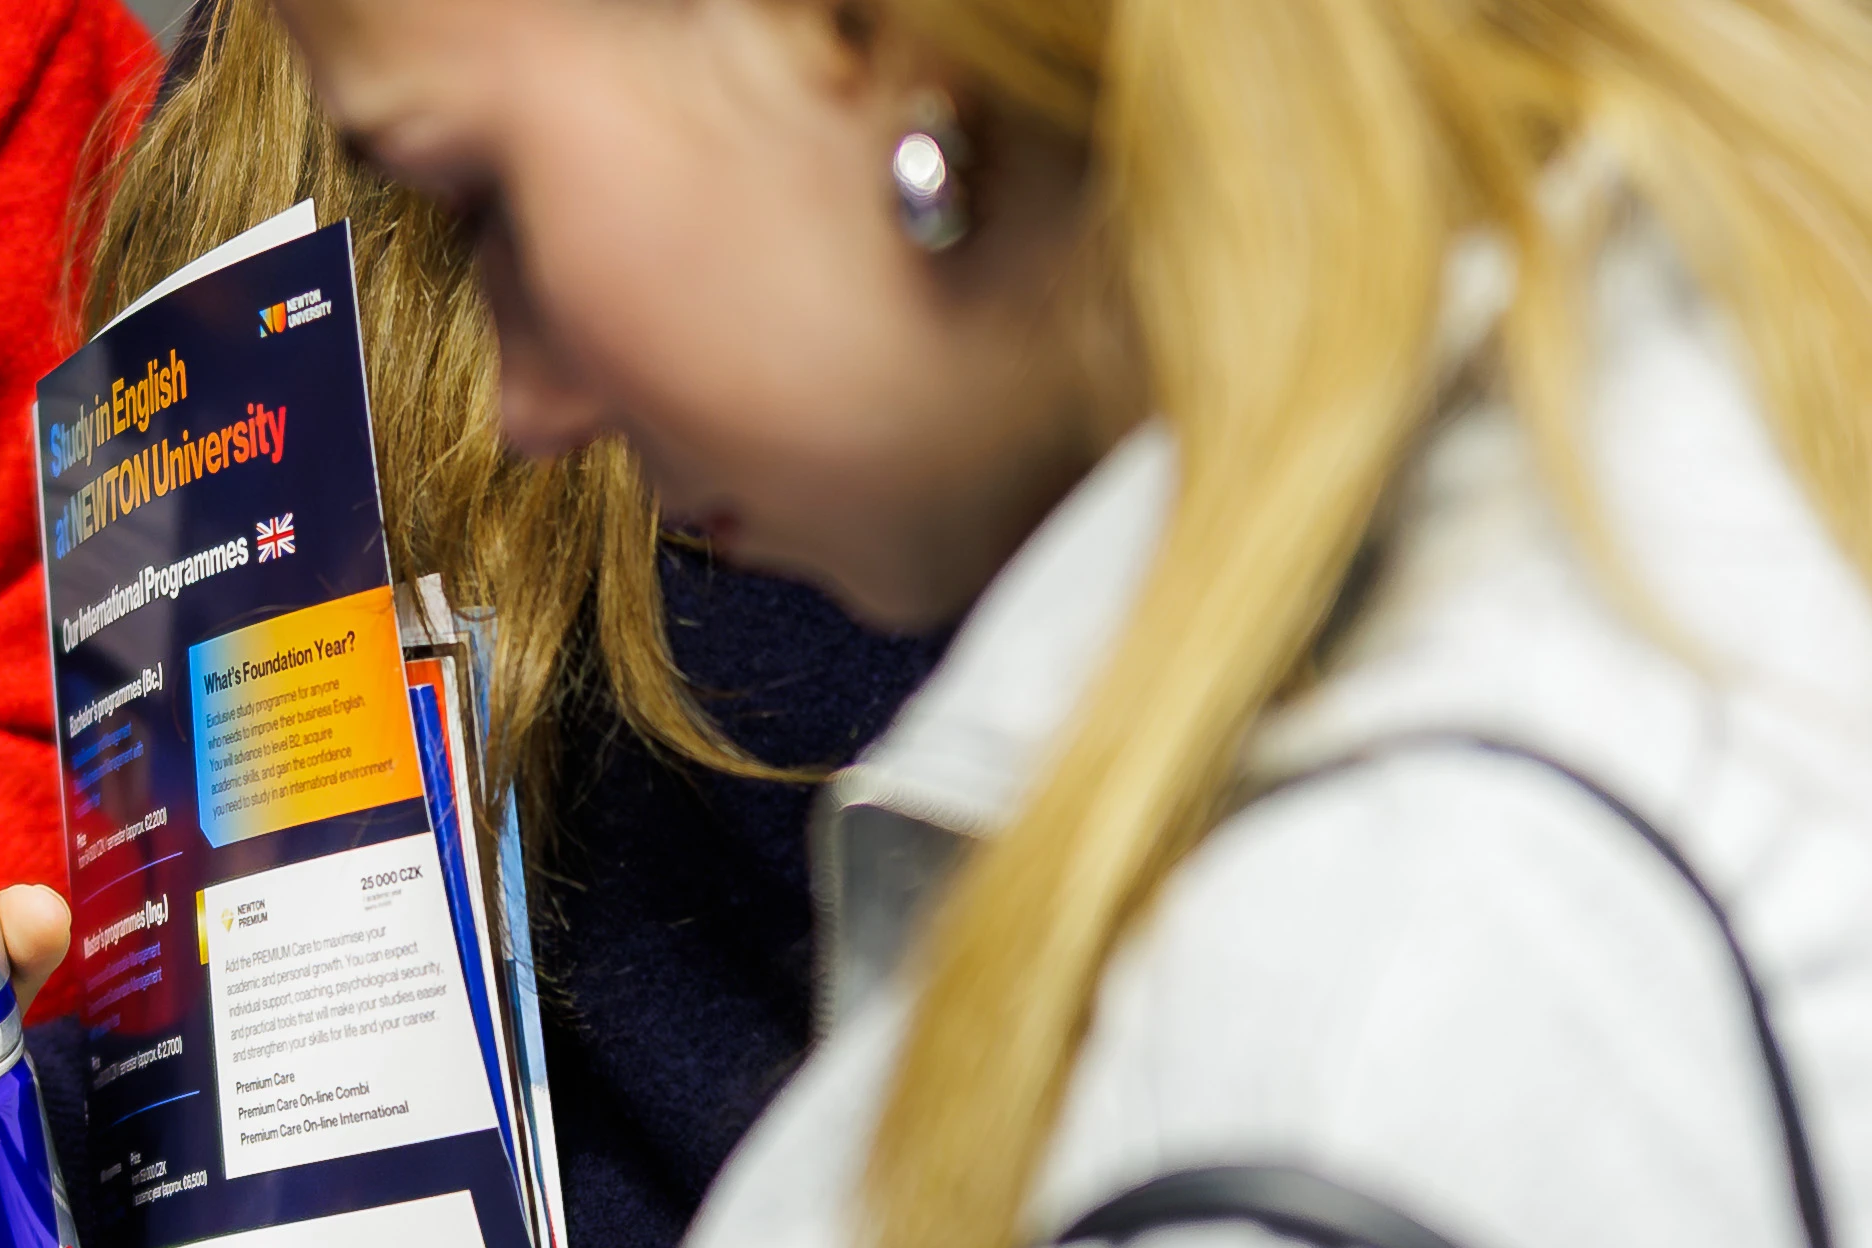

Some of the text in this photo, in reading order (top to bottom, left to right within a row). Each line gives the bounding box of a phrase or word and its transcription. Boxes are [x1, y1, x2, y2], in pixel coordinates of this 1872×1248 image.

[286, 288, 321, 312] NEWTON
[287, 301, 332, 329] UNIVERSITY
[49, 349, 187, 477] Study in English
[55, 403, 287, 559] at NEWTON University
[62, 537, 249, 652] Our International Programmes
[203, 631, 356, 695] What's Foundation Year?
[98, 680, 141, 715] programmes
[142, 662, 163, 697] (Bc.)
[236, 704, 254, 718] study
[255, 691, 296, 712] programme
[297, 683, 309, 701] for
[310, 680, 339, 696] anyone
[297, 705, 332, 723] business
[360, 866, 423, 890] 25 000 CZK
[145, 894, 168, 928] (Ing.)
[237, 901, 265, 914] NEWTON
[238, 913, 267, 926] PREMIUM
[384, 942, 417, 959] expect
[336, 970, 397, 995] psychological
[378, 985, 447, 1007] studies easier
[235, 1073, 295, 1093] Premium Care
[238, 1083, 370, 1119] Premium Care On-line Combi
[240, 1101, 409, 1144] Premium Care On-line International
